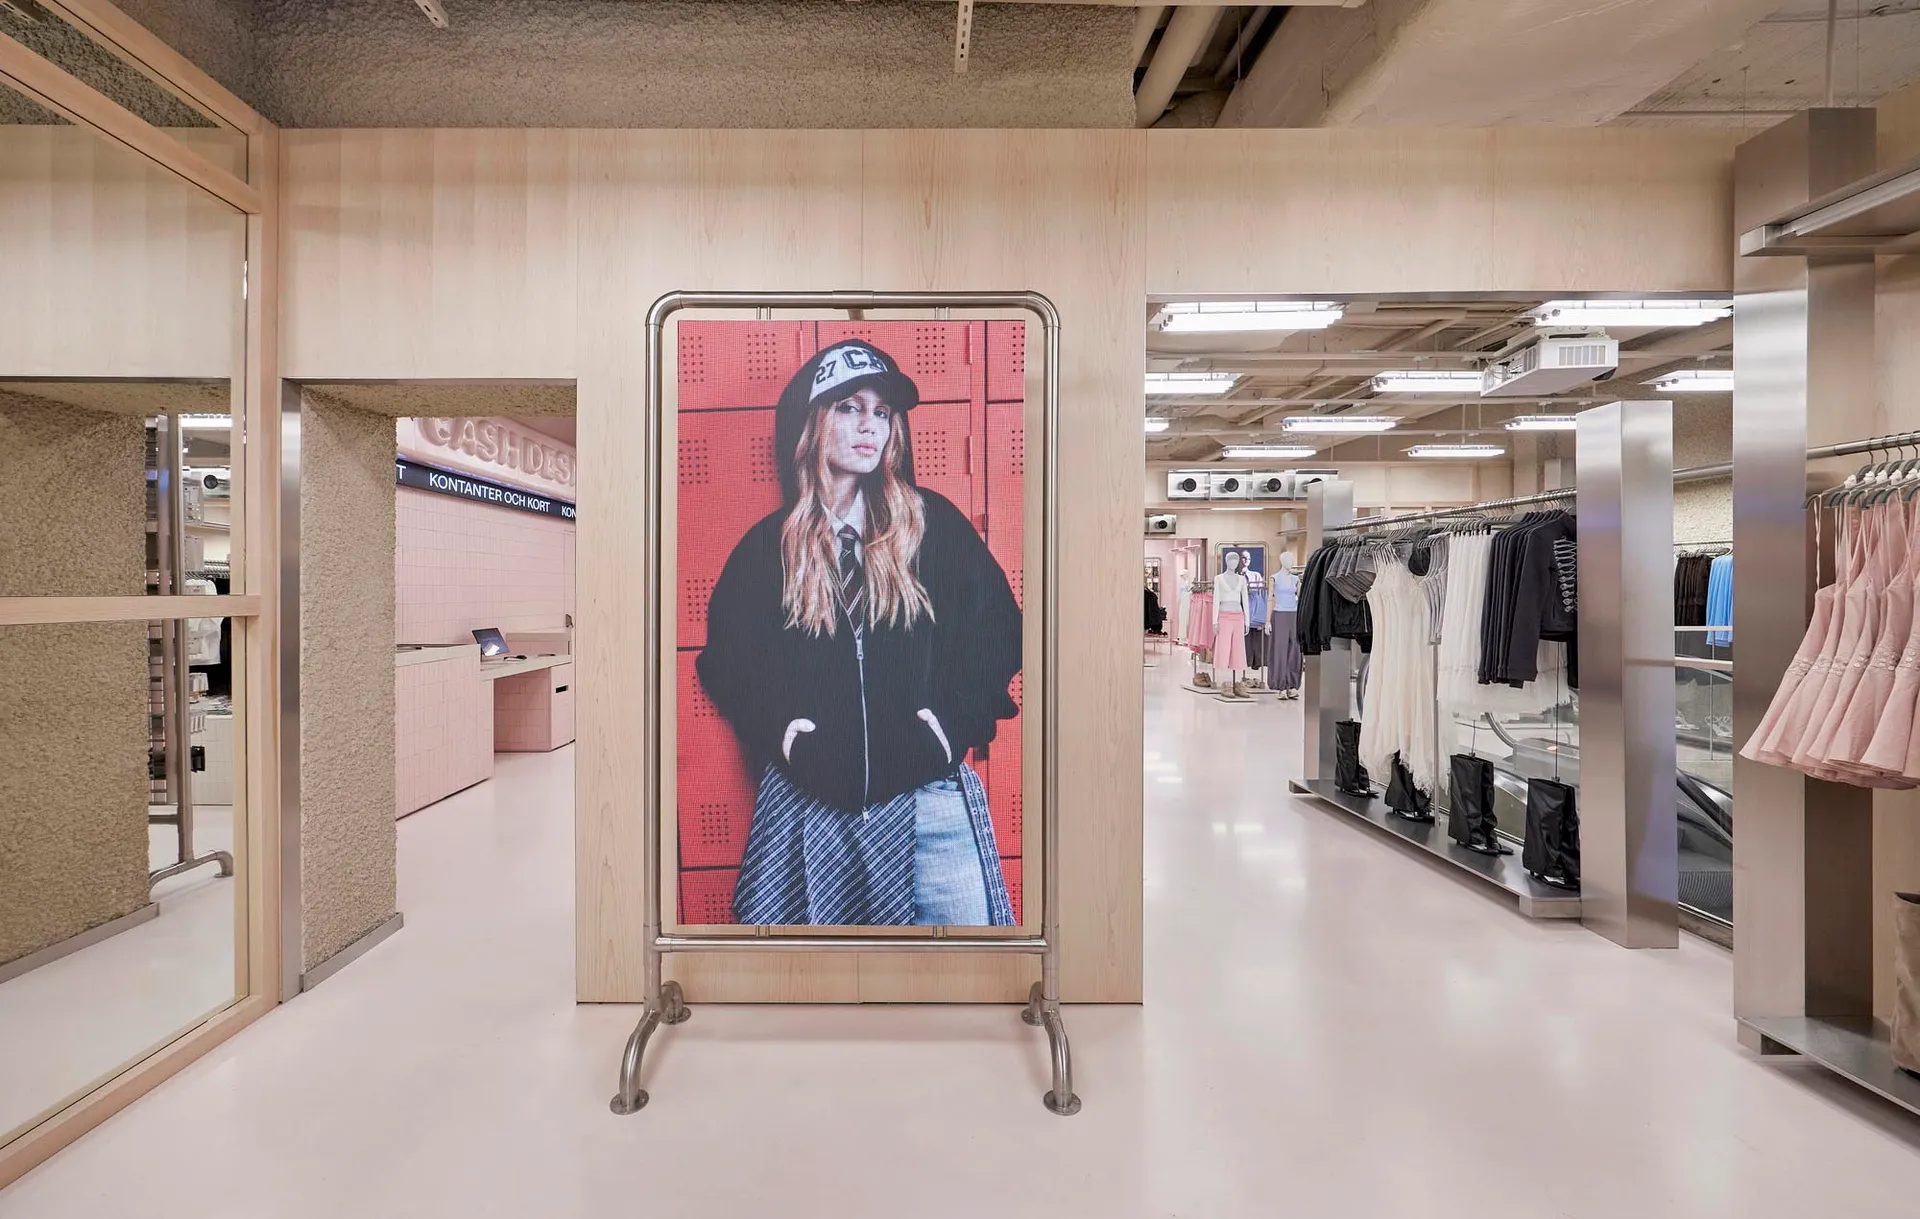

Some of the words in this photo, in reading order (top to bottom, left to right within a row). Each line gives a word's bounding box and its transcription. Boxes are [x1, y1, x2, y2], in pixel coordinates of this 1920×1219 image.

[815, 360, 837, 384] 27
[419, 417, 520, 468] CASH
[429, 472, 503, 502] KONTANTER
[504, 491, 527, 507] OCH
[527, 497, 550, 512] KORT
